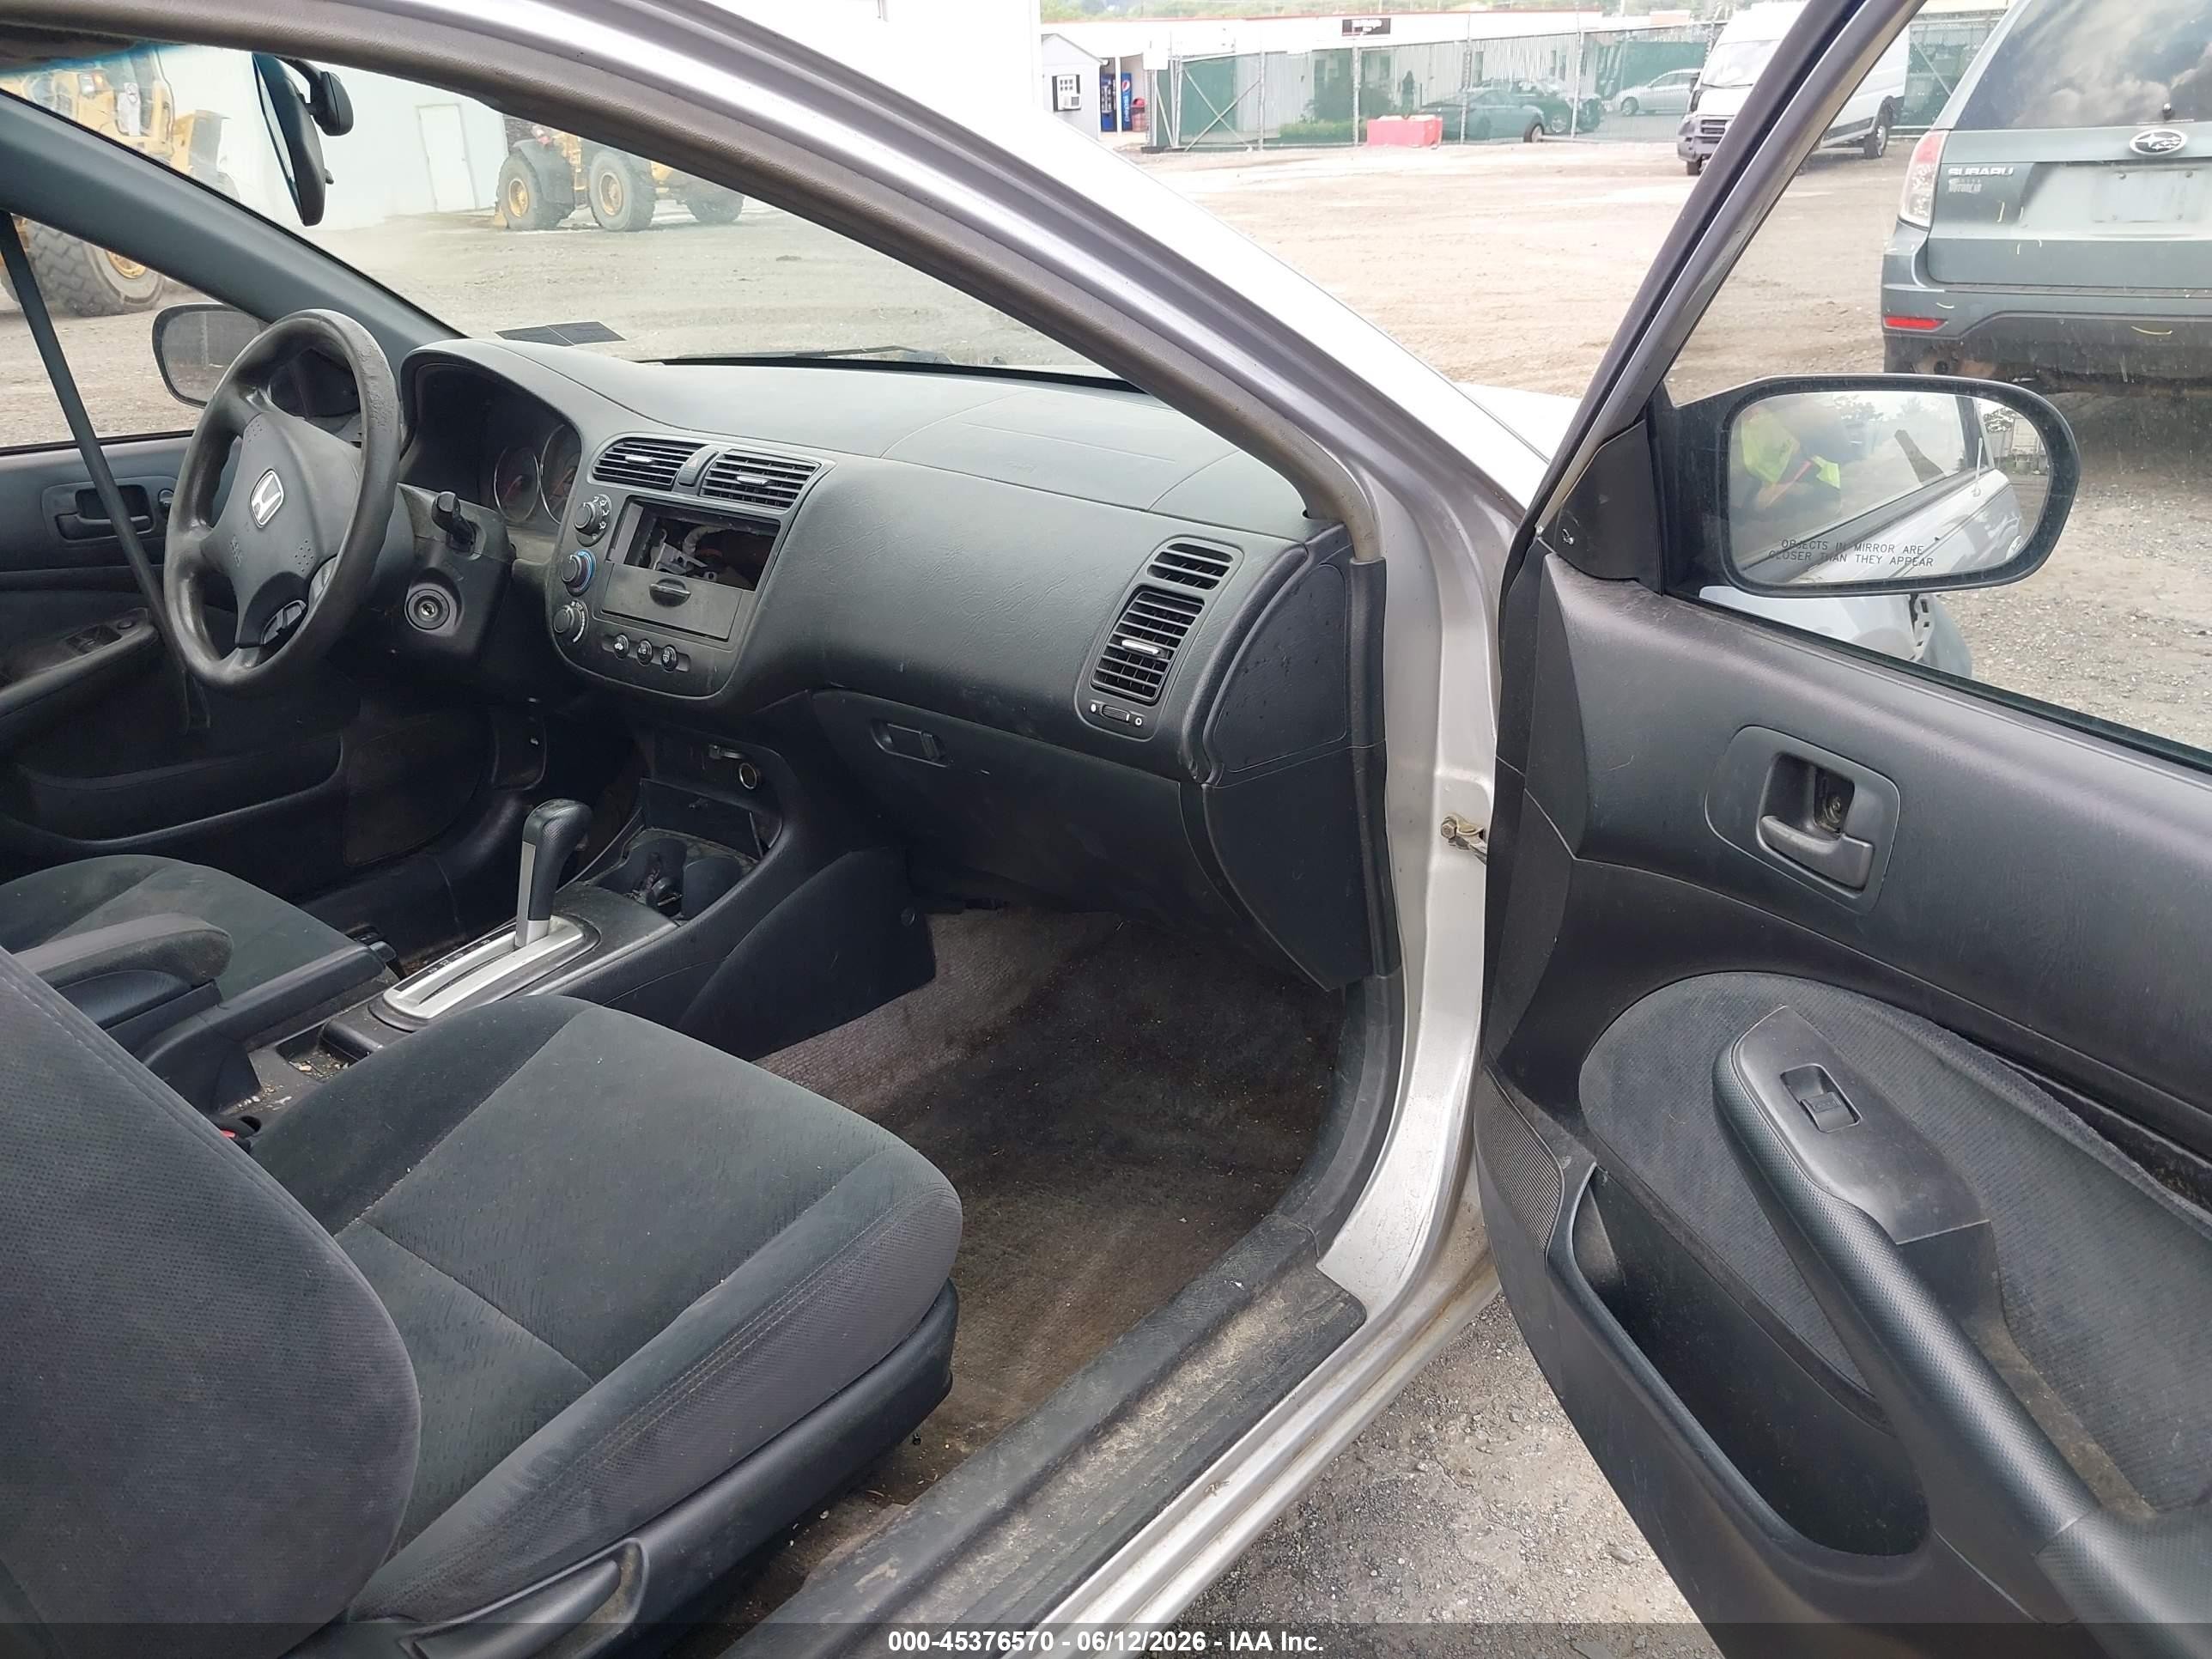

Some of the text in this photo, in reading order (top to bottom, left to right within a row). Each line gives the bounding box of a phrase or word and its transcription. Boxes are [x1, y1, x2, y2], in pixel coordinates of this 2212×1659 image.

[1948, 167, 2014, 176] SUBARU
[1781, 539, 1924, 555] OBJECTS IN MIRROR ARE
[1769, 550, 1933, 567] CLOSER THAN THEY APPEAR
